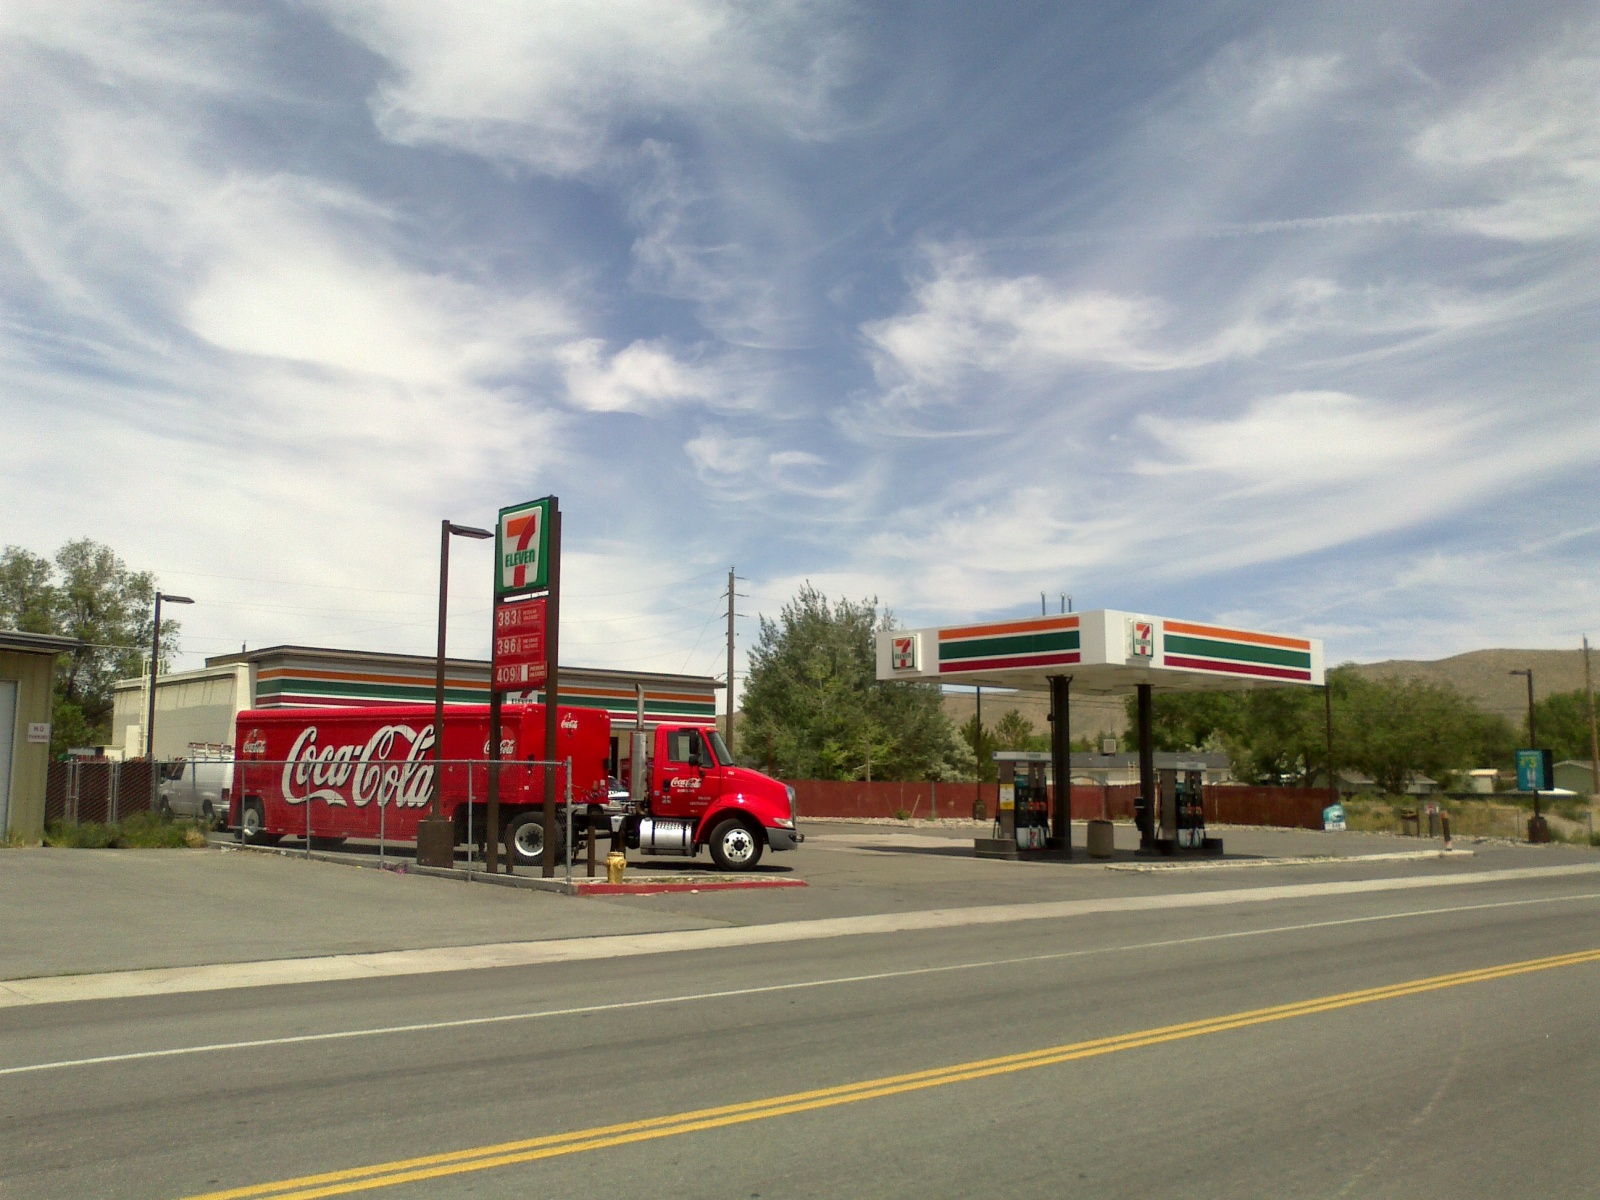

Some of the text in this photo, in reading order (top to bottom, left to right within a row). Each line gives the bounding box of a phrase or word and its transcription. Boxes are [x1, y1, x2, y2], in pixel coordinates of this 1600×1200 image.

[507, 513, 536, 588] 7
[498, 609, 517, 627] 383
[497, 637, 517, 655] 396
[1135, 623, 1150, 655] 7
[895, 638, 911, 668] 7
[497, 667, 516, 682] 409
[483, 739, 515, 755] CoCola
[281, 723, 436, 808] Coca-Cola
[671, 777, 701, 787] Coca-Cola
